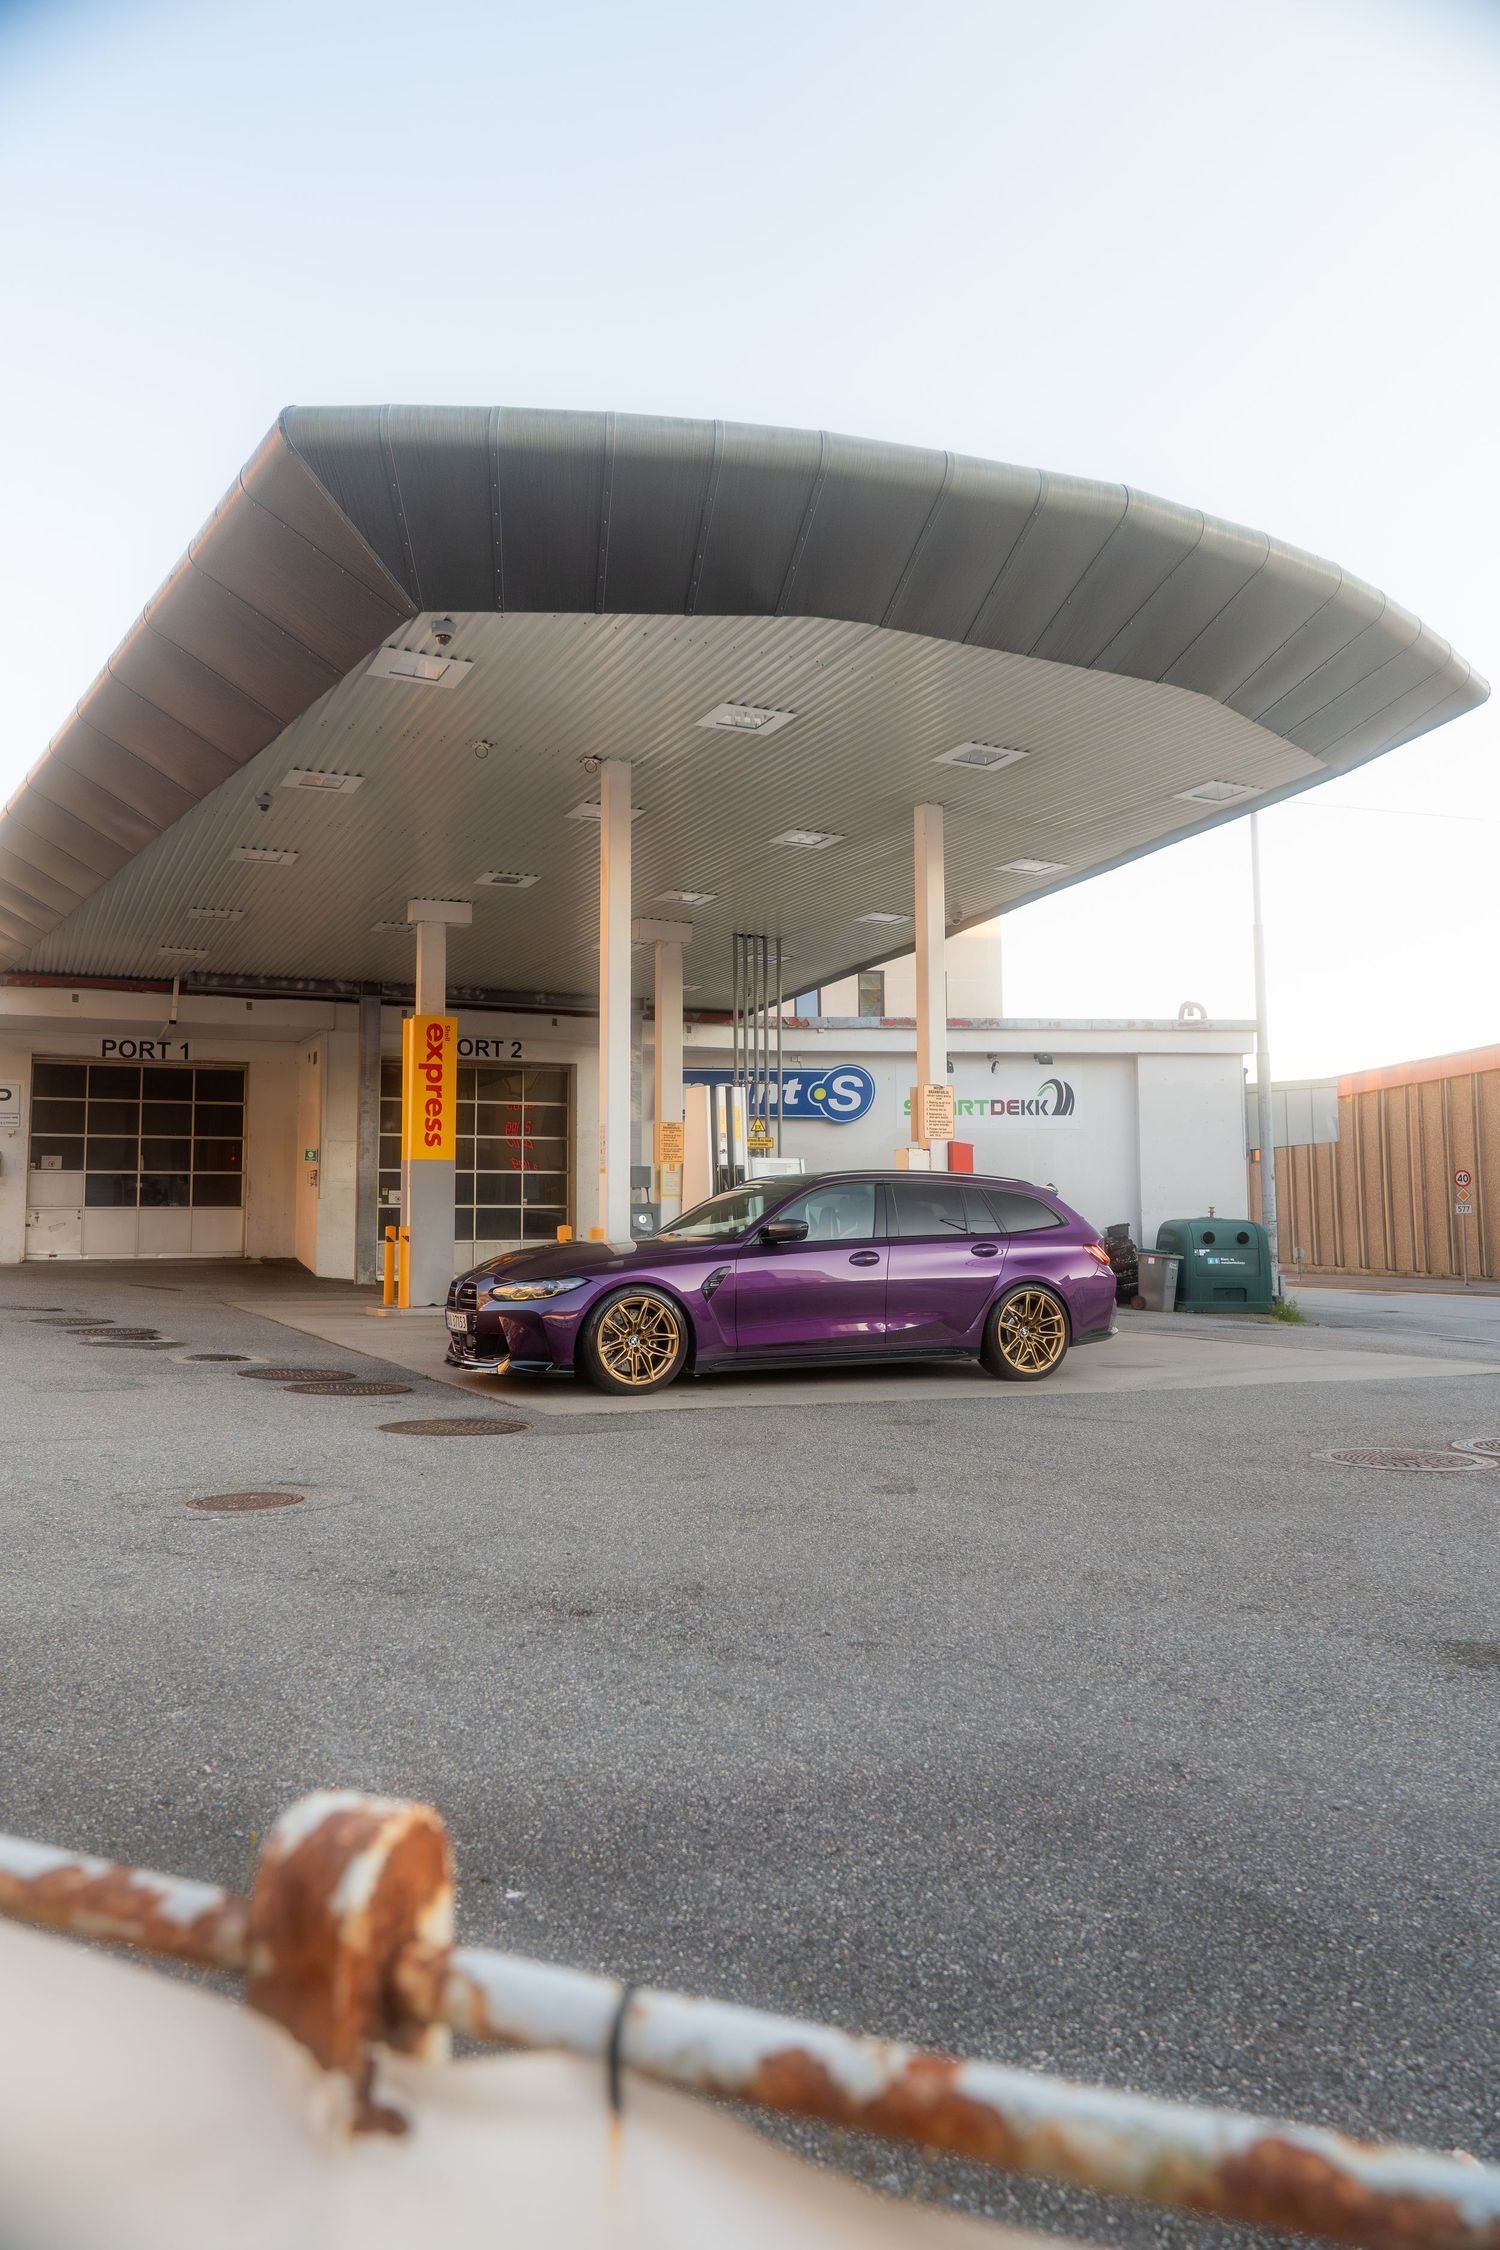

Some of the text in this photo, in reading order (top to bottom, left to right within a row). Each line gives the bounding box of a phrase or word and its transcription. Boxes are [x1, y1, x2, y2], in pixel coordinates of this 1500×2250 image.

[102, 1040, 189, 1060] PORT 1
[457, 1039, 522, 1058] ORT 2
[418, 1023, 444, 1147] express
[828, 1075, 864, 1112] S
[903, 1099, 1049, 1116] SRTDEKK
[1457, 1174, 1469, 1183] 40
[1457, 1205, 1470, 1213] 577
